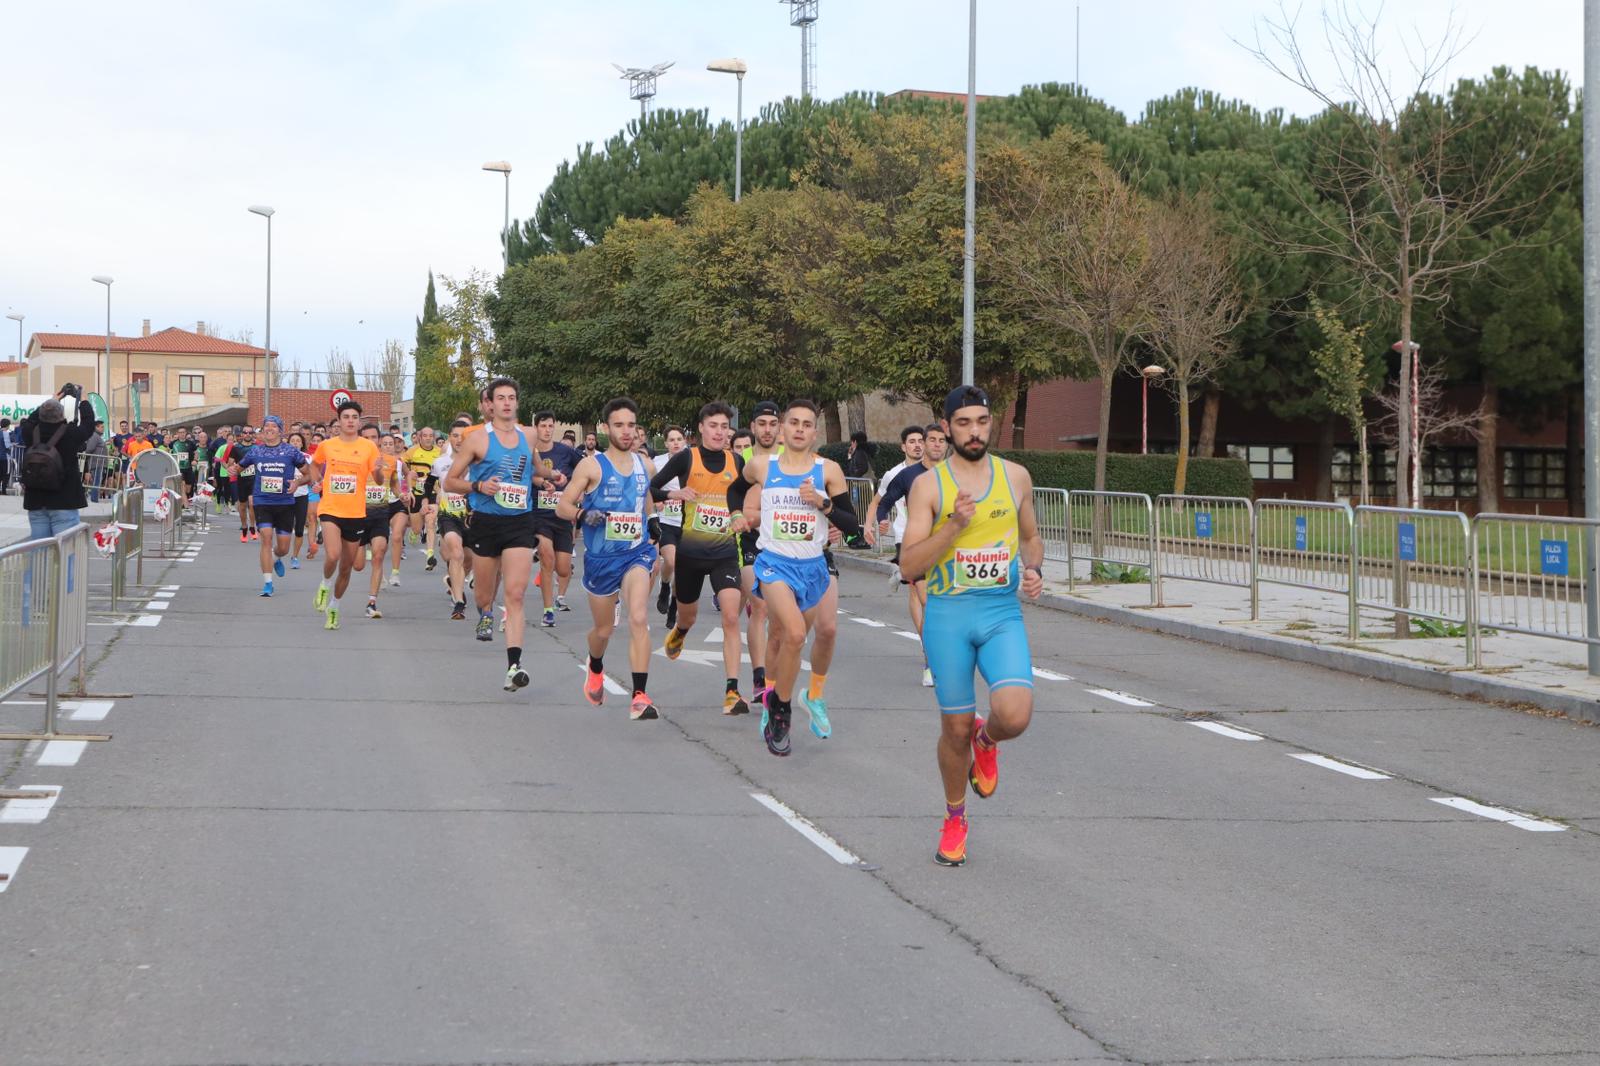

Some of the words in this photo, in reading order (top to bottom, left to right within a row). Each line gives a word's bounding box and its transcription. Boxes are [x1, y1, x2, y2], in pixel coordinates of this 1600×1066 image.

[334, 482, 351, 490] 207
[502, 492, 521, 504] 155
[771, 495, 781, 505] LA
[701, 514, 724, 528] 393
[773, 511, 816, 522] bedunia
[614, 522, 636, 535] 396
[780, 521, 808, 535] 358
[956, 551, 1009, 563] bedunia
[966, 563, 999, 579] 366
